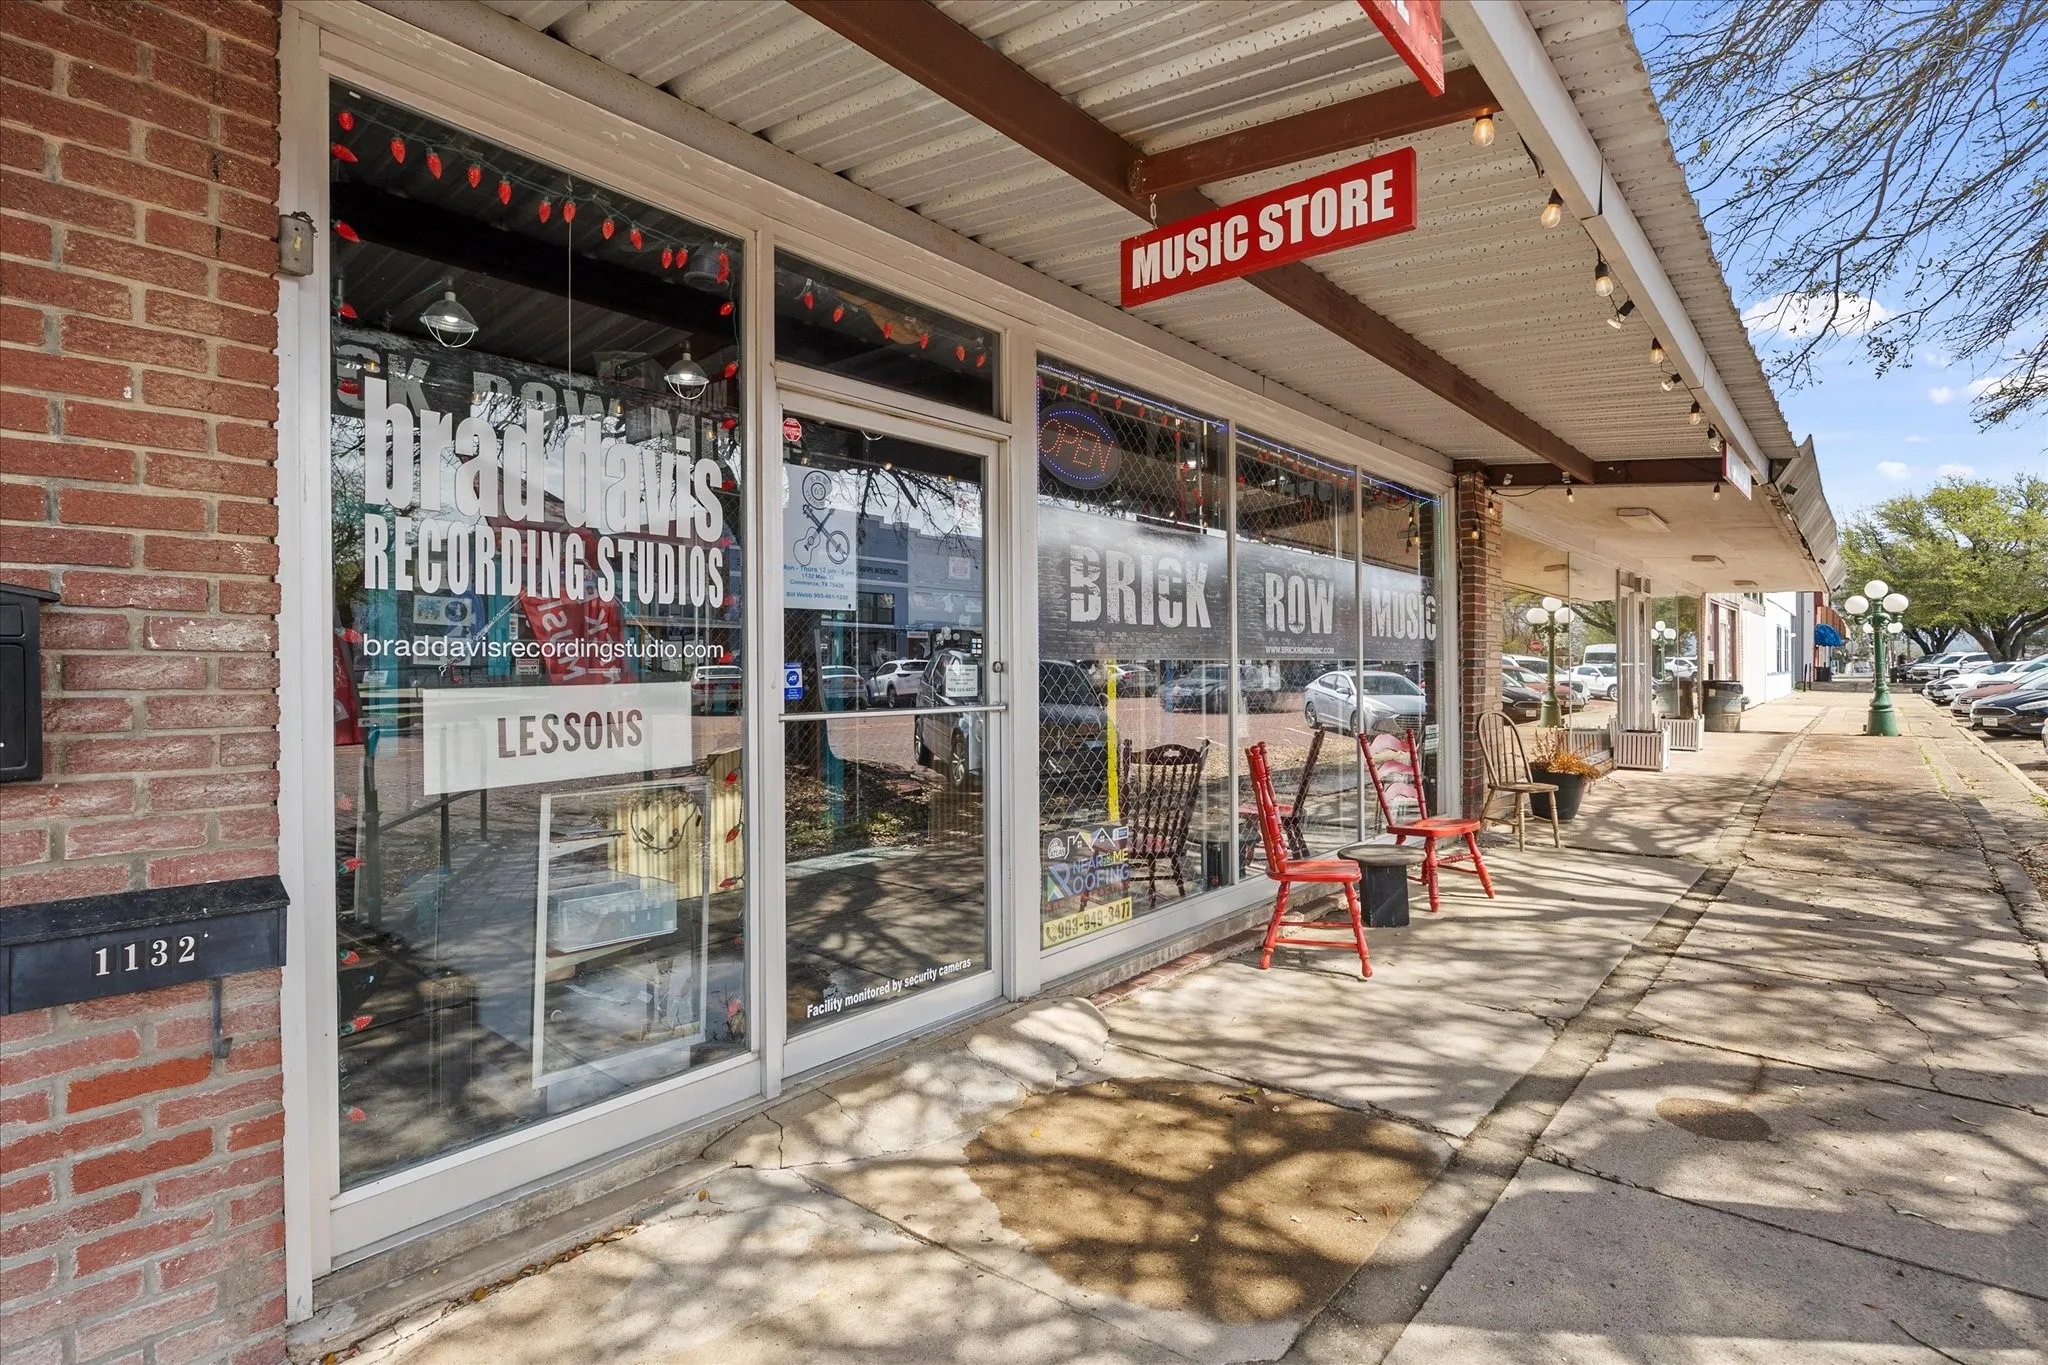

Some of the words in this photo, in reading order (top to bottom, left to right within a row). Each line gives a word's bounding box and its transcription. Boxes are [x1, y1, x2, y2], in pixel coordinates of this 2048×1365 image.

[1132, 214, 1249, 290] MUSIC
[1258, 169, 1395, 252] STORE
[364, 377, 546, 524] brad
[564, 418, 724, 543] davis
[1039, 418, 1114, 472] OPEN
[364, 514, 585, 600] RECORDING
[598, 535, 724, 609] STUDIOS
[1069, 544, 1212, 629] BRICK
[1265, 572, 1336, 635] ROW
[1371, 588, 1437, 641] MUSIC
[362, 634, 725, 663] braddavisrecordingstudio.com
[1265, 646, 1335, 655] WWW.BRICKROWMUSIC.COM
[497, 709, 644, 759] LESSONS
[1050, 846, 1066, 859] ATLAS
[1073, 855, 1105, 874] NEAR
[1113, 848, 1129, 864] ME
[1048, 862, 1130, 897] ROOFING
[1058, 901, 1130, 939] 903-949-3477
[95, 935, 196, 977] 1132
[807, 996, 843, 1019] Facility
[844, 980, 890, 1007] monitored
[892, 978, 903, 993] by
[904, 967, 938, 988] security
[938, 958, 972, 976] cameras
